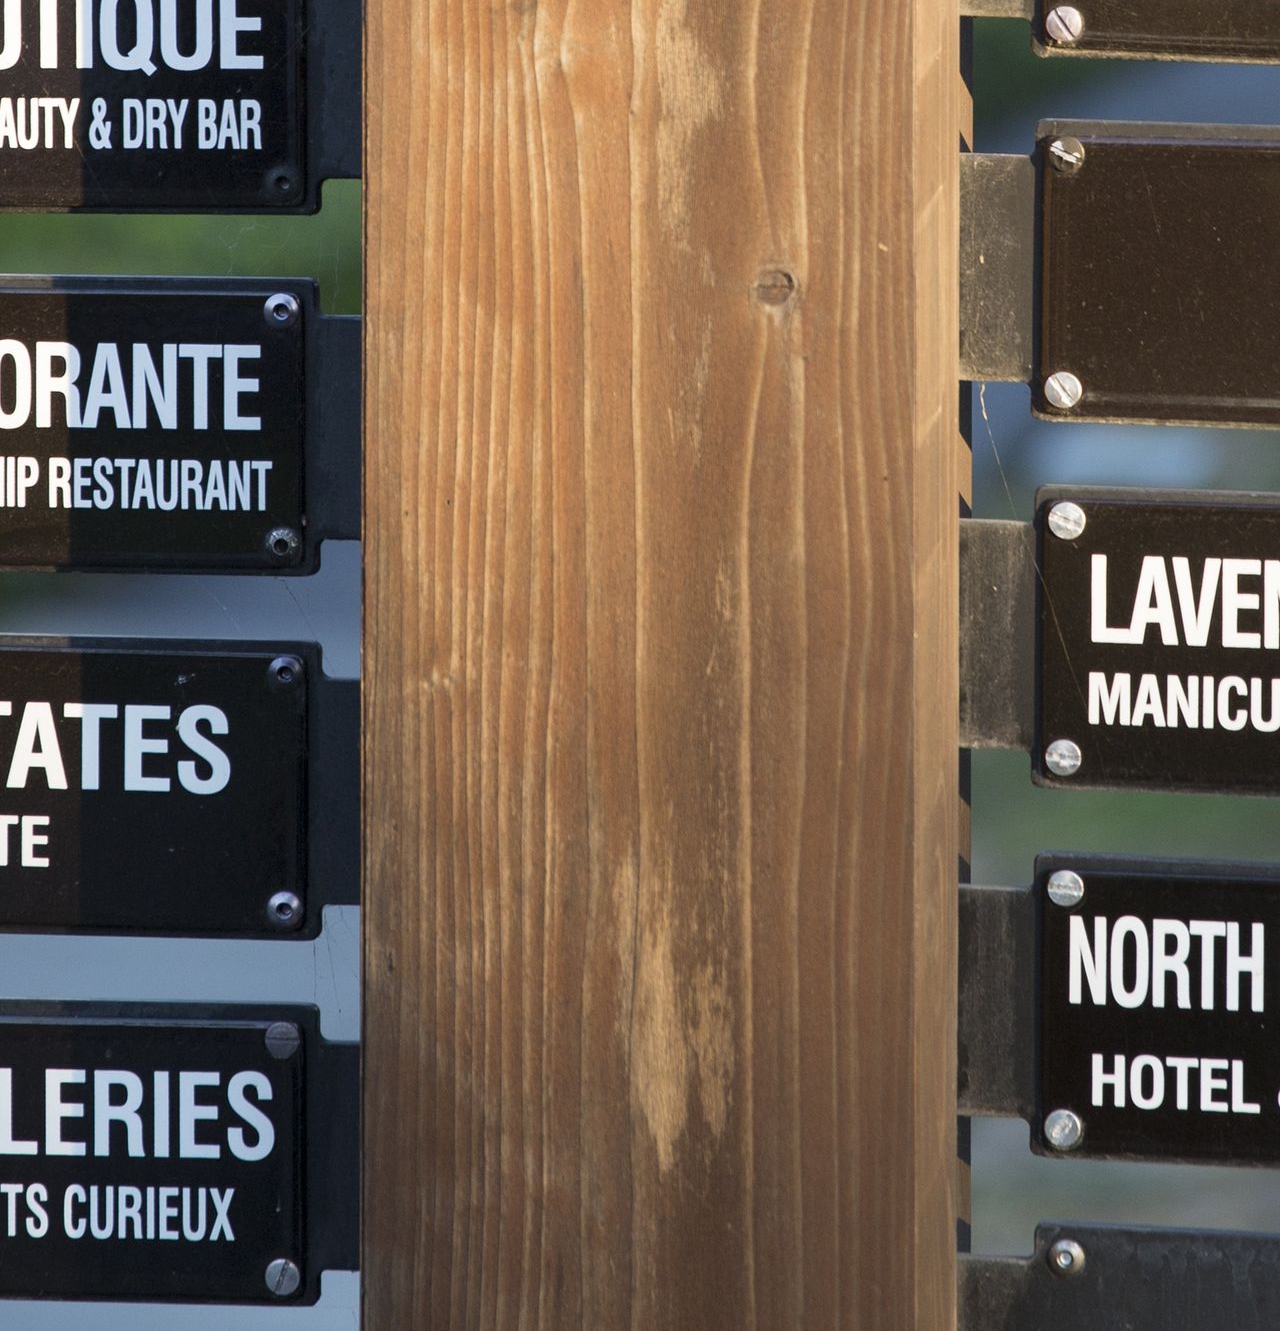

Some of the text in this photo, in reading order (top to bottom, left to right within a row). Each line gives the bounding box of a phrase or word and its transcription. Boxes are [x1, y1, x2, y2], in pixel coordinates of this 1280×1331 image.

[88, 97, 113, 150] &
[122, 98, 189, 150] DRY
[198, 98, 262, 150] BAR
[48, 456, 273, 511] RESTAURANT
[1068, 915, 1265, 1013] NORTH
[1091, 1053, 1261, 1114] HOTEL
[63, 1183, 235, 1241] CURIEUX
